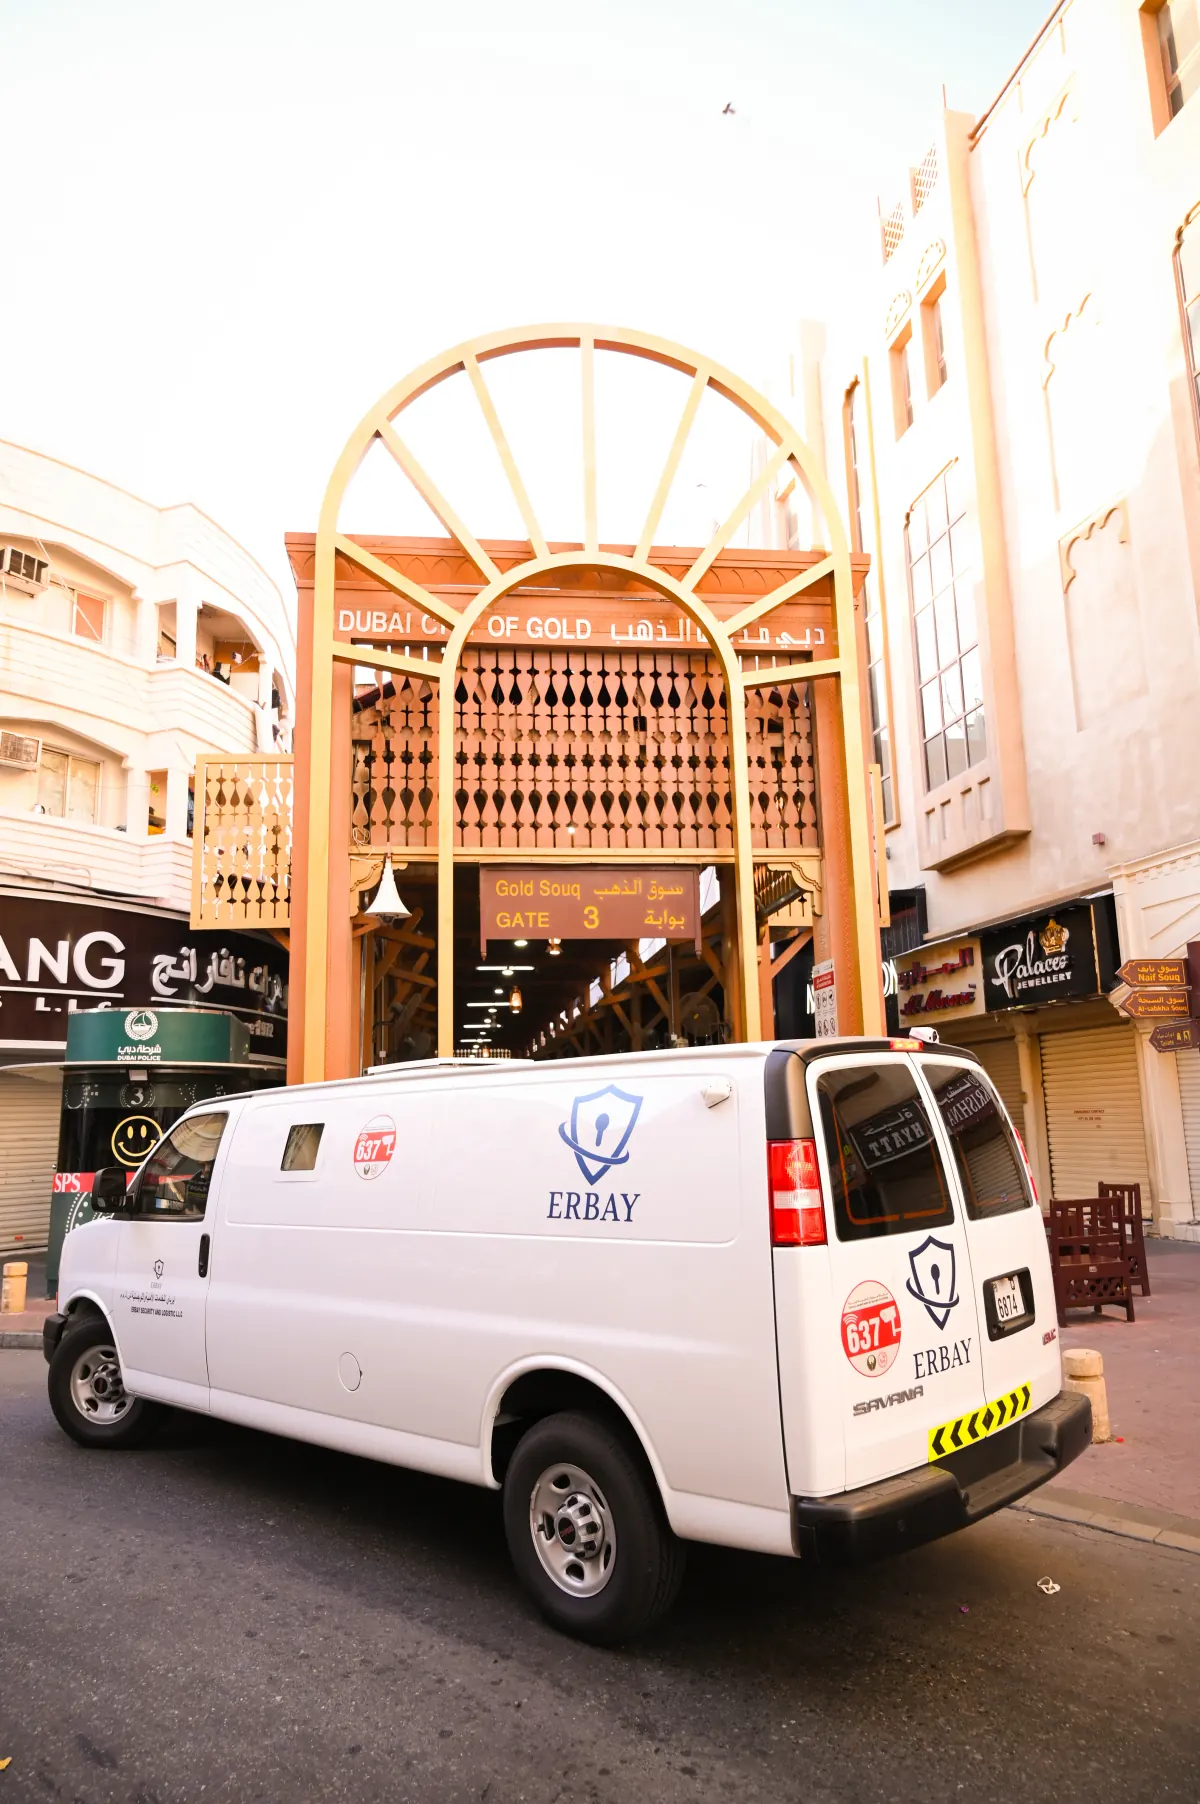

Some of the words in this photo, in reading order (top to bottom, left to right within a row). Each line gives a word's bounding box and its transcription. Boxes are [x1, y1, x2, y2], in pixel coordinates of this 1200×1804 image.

[338, 609, 412, 634] DUBAI
[487, 615, 519, 638] OF
[526, 616, 592, 640] GOLD
[610, 618, 691, 645] الذهب
[775, 627, 825, 648] دبي
[495, 879, 534, 897] Gold
[539, 880, 581, 900] Souq
[593, 879, 643, 900] الذهب
[646, 880, 684, 900] سوق
[496, 911, 550, 928] GATE
[583, 905, 600, 929] 3
[644, 909, 686, 930] بوابة
[992, 930, 1070, 998] Palaces
[1157, 964, 1179, 974] سوق
[1016, 971, 1073, 990] JEWELLERY
[1138, 973, 1156, 982] Naif
[1157, 973, 1181, 983] Souq
[1170, 1004, 1187, 1012] Souq
[117, 1046, 137, 1055] دبي
[137, 1043, 162, 1056] شرطة
[130, 1086, 145, 1105] 3
[355, 1139, 382, 1161] 637
[54, 1172, 81, 1193] SPS
[546, 1191, 641, 1222] ERBAY
[140, 1307, 155, 1315] SECURITY
[998, 1293, 1018, 1319] 6874
[846, 1316, 880, 1353] 637
[913, 1338, 972, 1380] ERBAY
[852, 1384, 924, 1417] SAVANA
